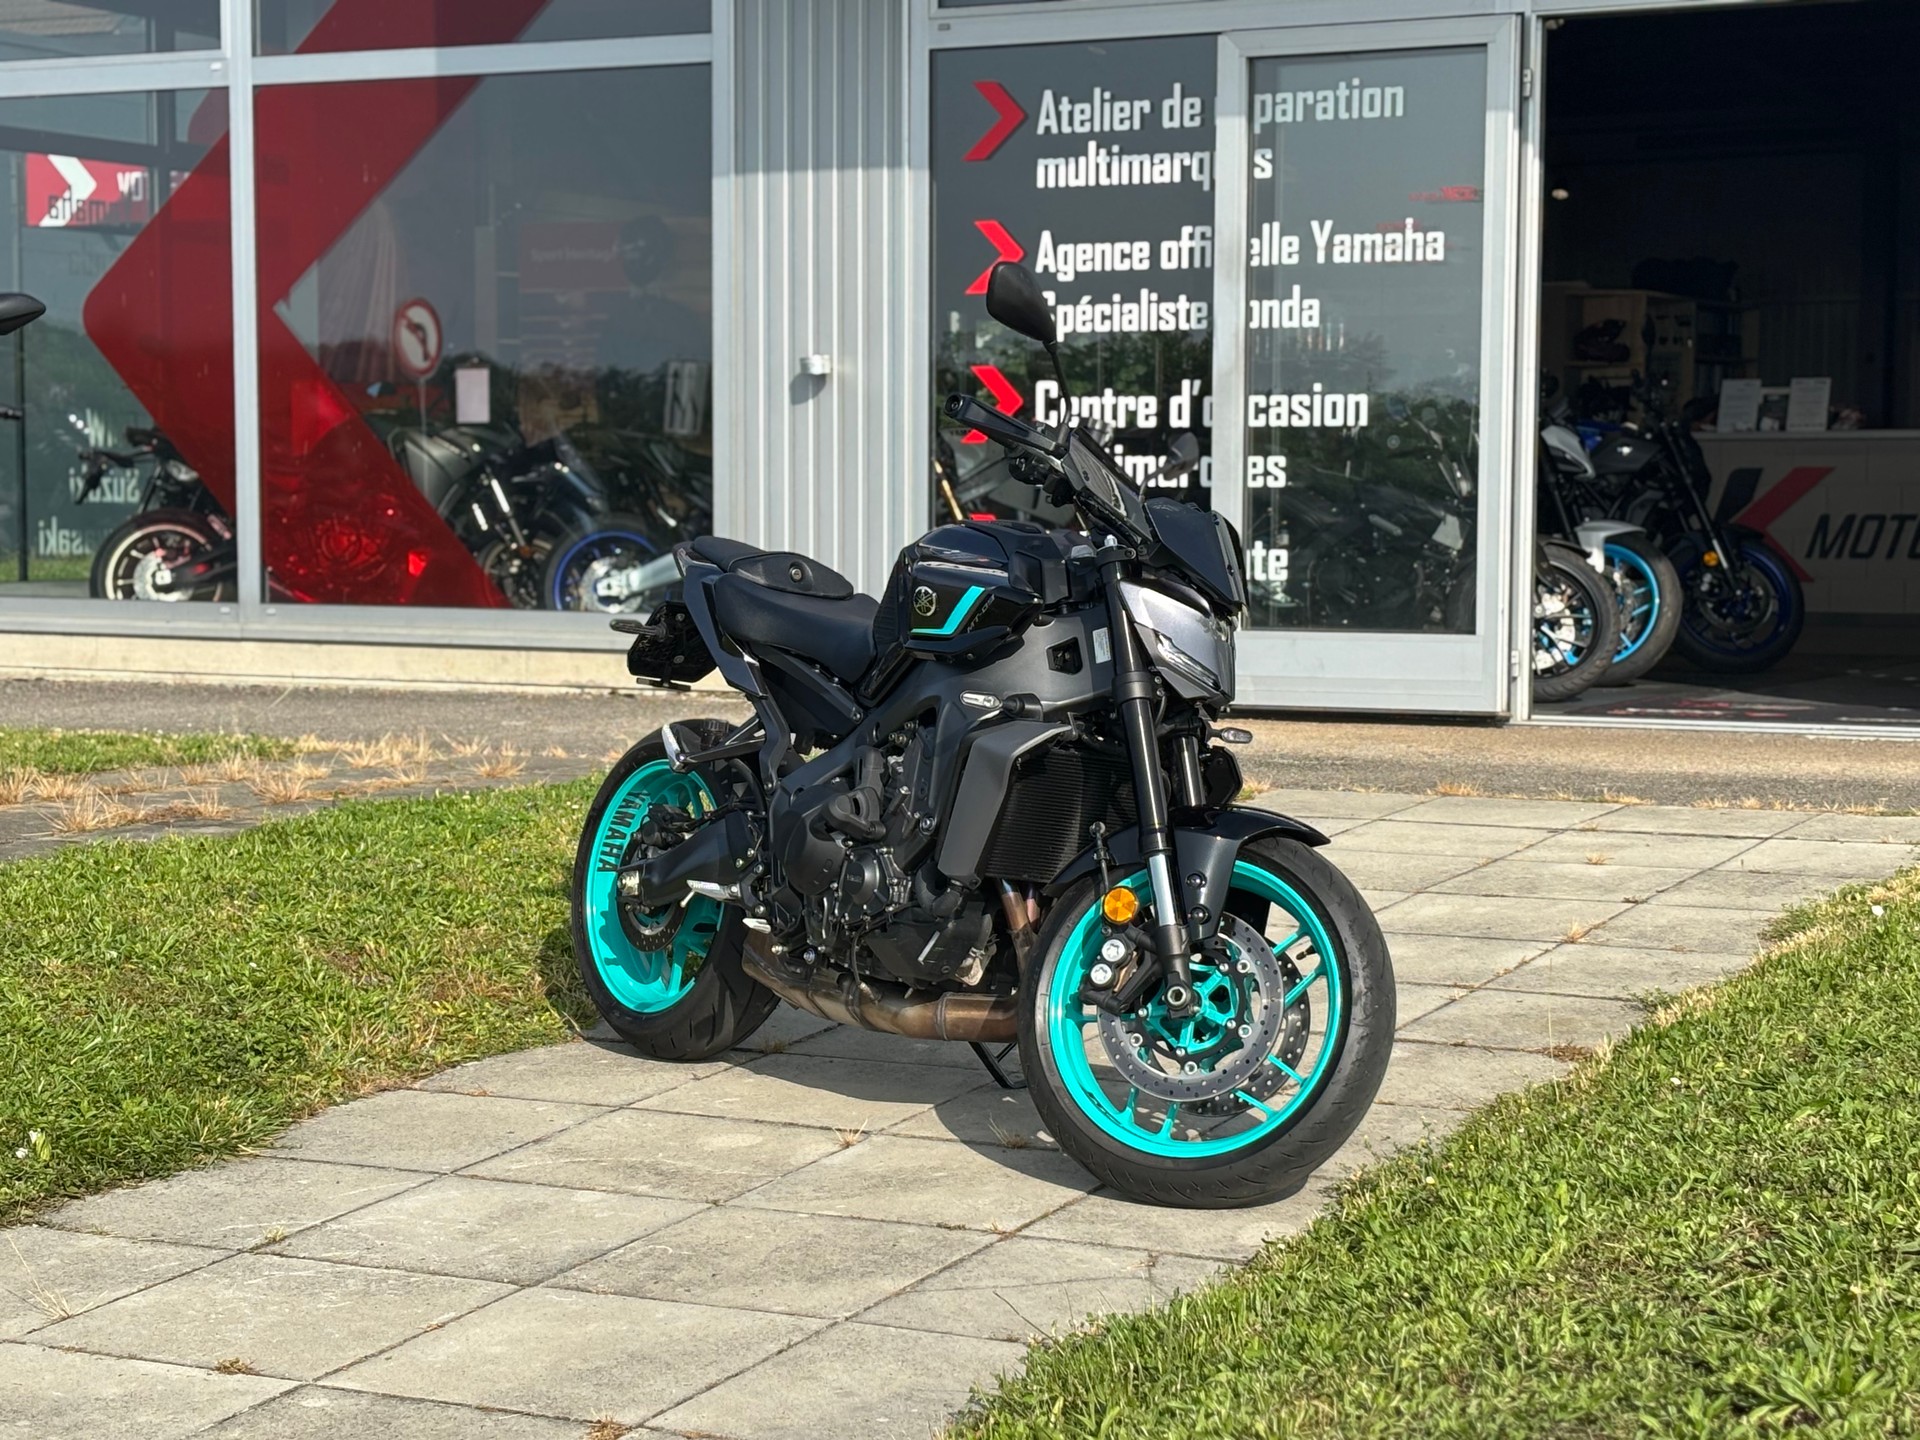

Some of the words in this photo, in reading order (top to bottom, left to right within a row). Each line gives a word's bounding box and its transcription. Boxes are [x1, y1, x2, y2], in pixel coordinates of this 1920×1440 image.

[1036, 87, 1151, 135] Atelier
[1162, 82, 1202, 129] de
[1214, 77, 1404, 134] paration
[1036, 140, 1273, 192] multimarqs
[1035, 230, 1150, 282] Agence
[1160, 221, 1299, 270] offielle
[1310, 217, 1445, 264] Yamaha
[1249, 284, 1320, 329] onda
[1246, 540, 1289, 582] te
[596, 790, 650, 872] YAMAHA
